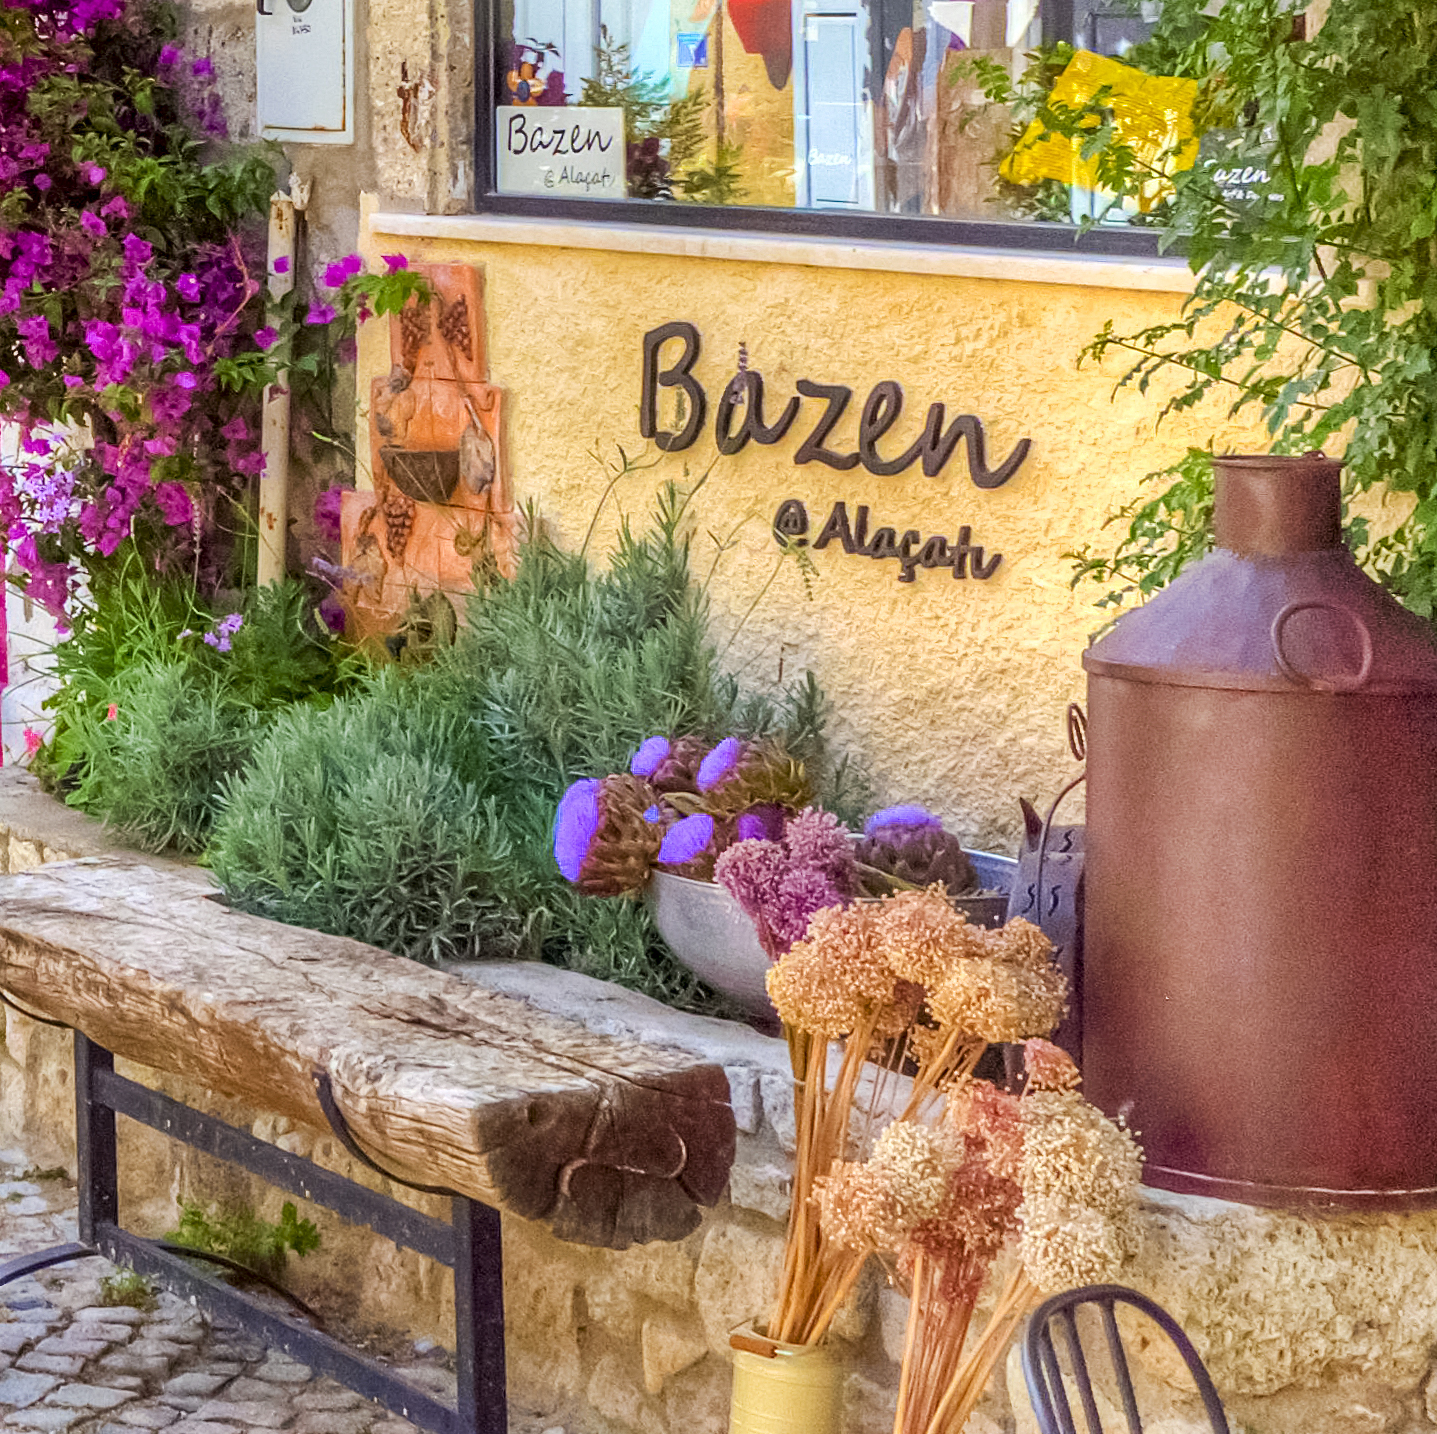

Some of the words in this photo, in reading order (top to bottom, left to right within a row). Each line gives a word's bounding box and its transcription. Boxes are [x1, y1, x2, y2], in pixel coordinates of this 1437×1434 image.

[508, 113, 613, 155] Bazen
[1204, 159, 1271, 184] azen
[640, 321, 1032, 490] Bazen
